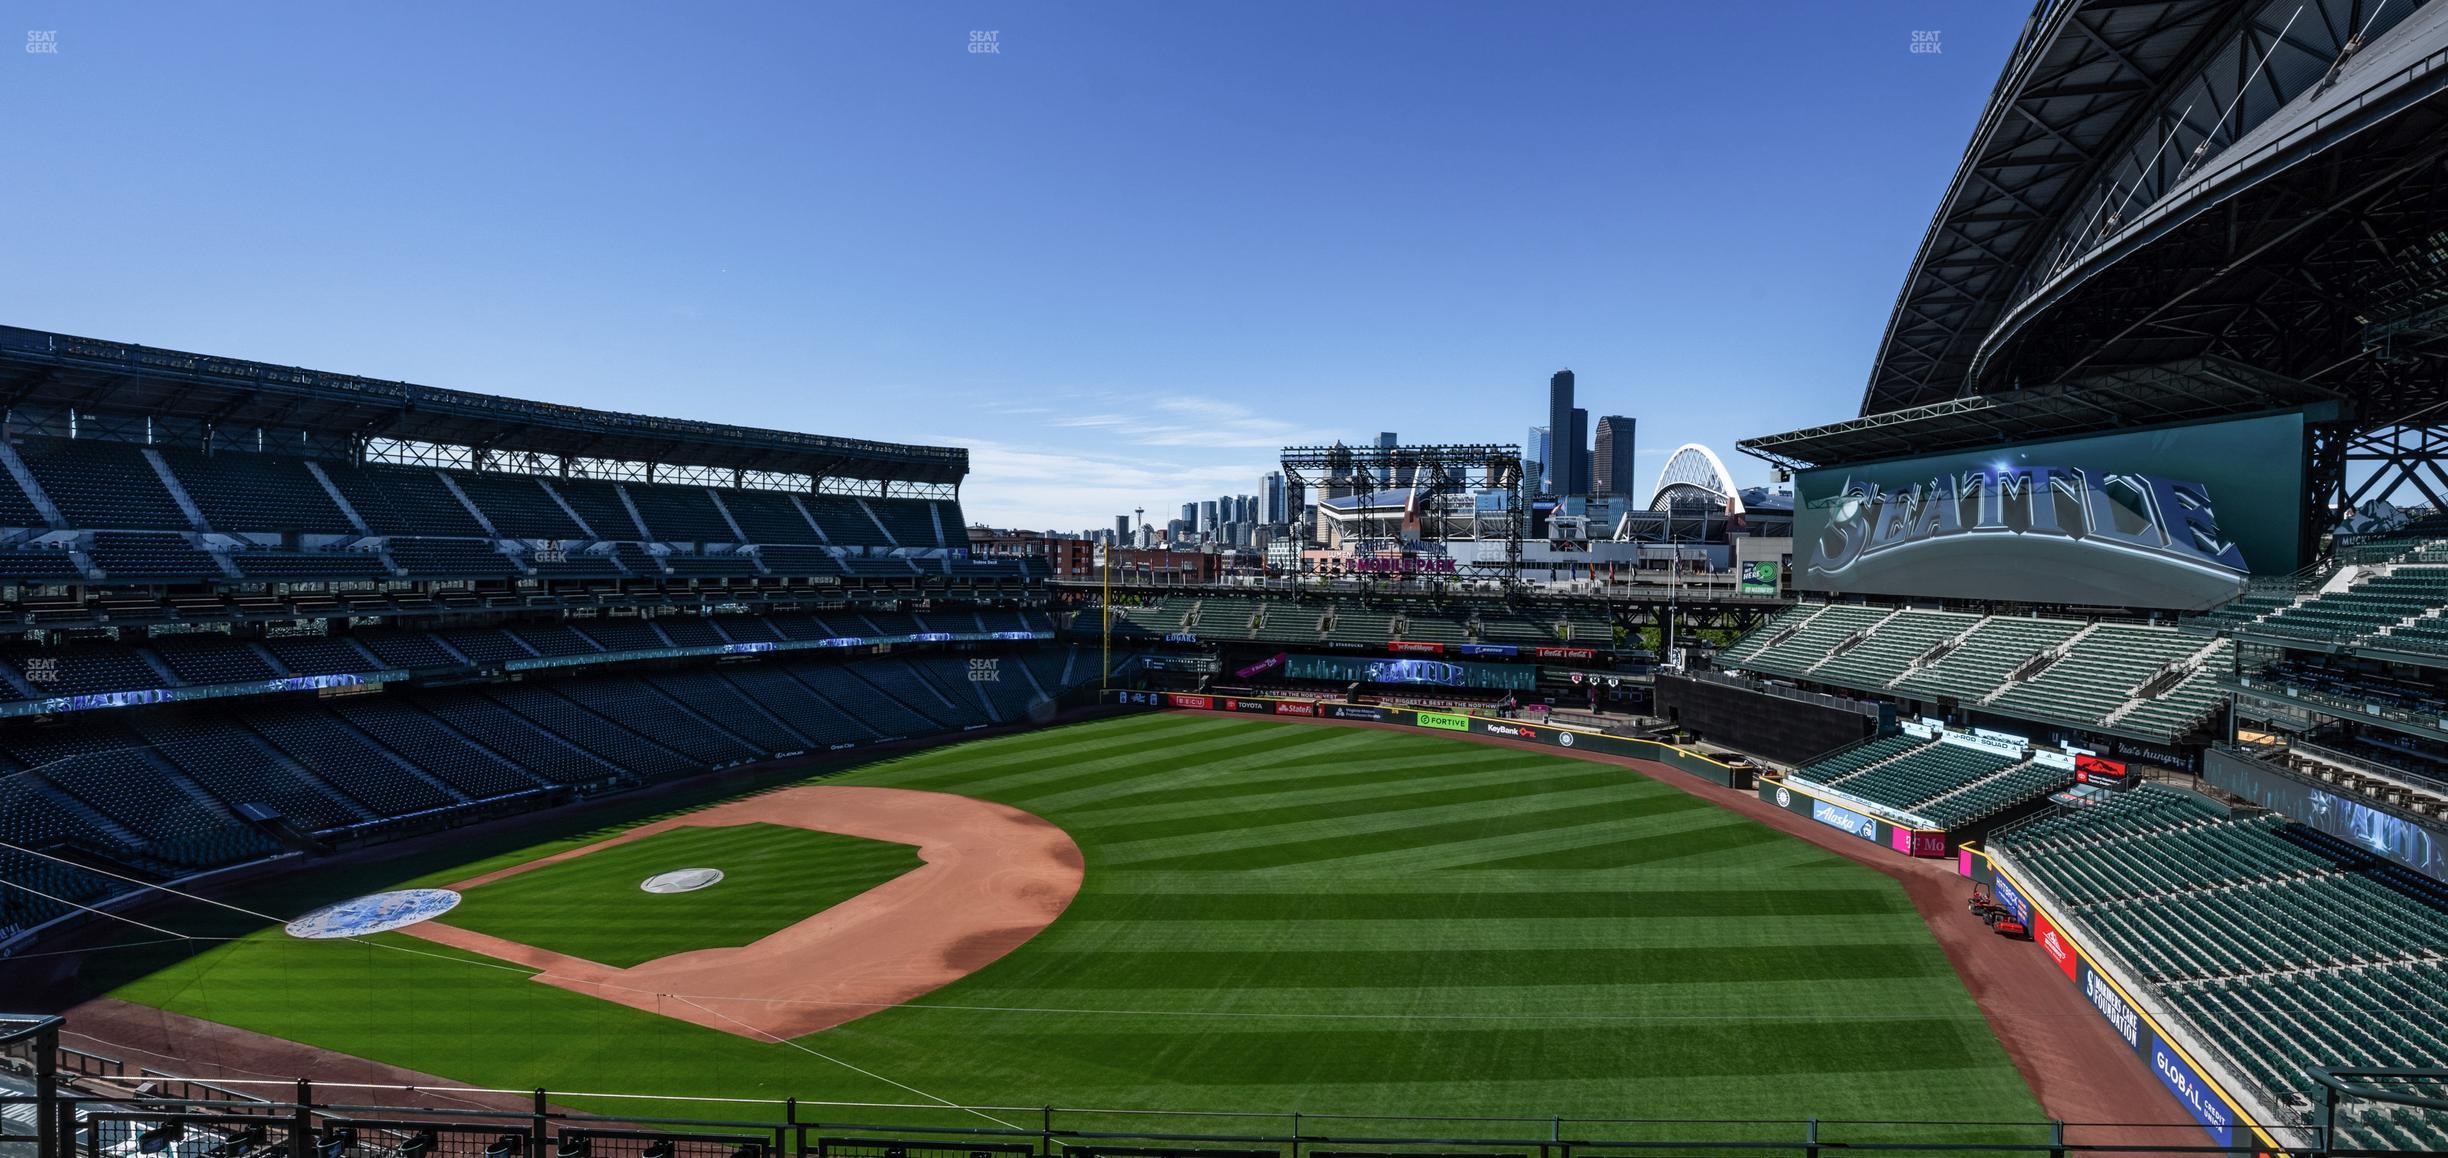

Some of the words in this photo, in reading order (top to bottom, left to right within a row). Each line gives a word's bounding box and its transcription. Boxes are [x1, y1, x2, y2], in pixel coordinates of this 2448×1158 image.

[1809, 466, 2251, 574] SEATTLE
[1346, 559, 1413, 571] T-MOBILE
[1416, 560, 1456, 571] PARK
[1179, 698, 1203, 706] BECU
[1238, 701, 1262, 709] TOYOTA
[1431, 717, 1465, 727] FORTIVE
[1488, 723, 1519, 736] KeyBank
[1953, 734, 1976, 742] J-ROD
[1981, 739, 2008, 749] SQUAD
[1816, 806, 1855, 829] Alaska
[2095, 975, 2122, 1013] MARINERS
[2122, 1004, 2138, 1030] CARE
[2094, 989, 2137, 1048] FOUNDATION
[2157, 1051, 2202, 1112] GLOBAL
[2203, 1108, 2223, 1133] UNION
[2204, 1099, 2226, 1126] CREDIT
